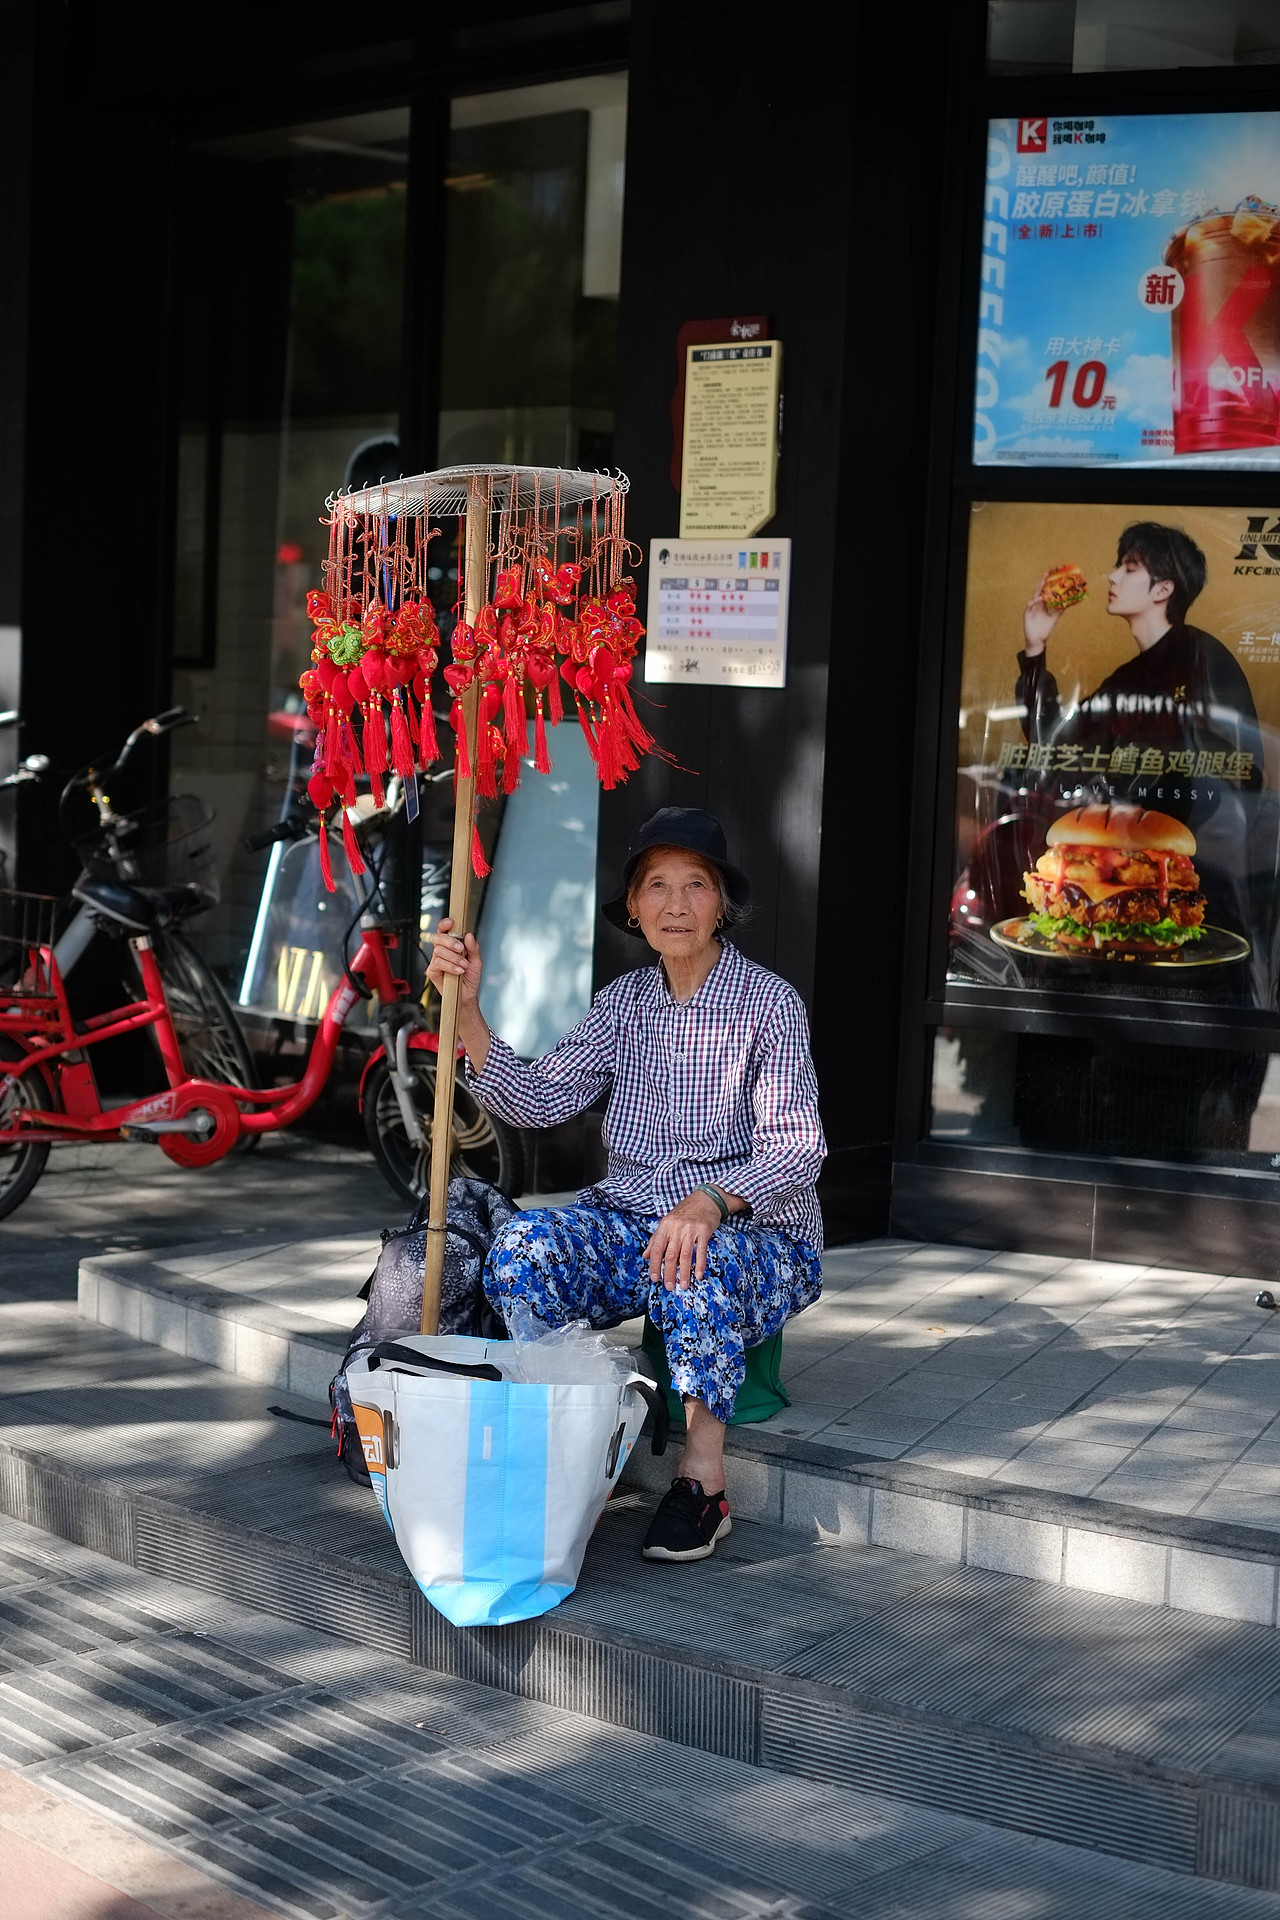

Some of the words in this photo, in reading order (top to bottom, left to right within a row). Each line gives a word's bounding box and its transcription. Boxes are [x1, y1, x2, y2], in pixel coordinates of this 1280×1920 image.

[1011, 189, 1209, 219] 胶原蛋白冰拿铁
[1145, 274, 1176, 305] 新
[1044, 336, 1121, 357] 用大神卡
[996, 741, 1255, 780] 脏脏芝士鳕鱼鸡腿堡
[1059, 783, 1116, 797] LOVE
[1138, 786, 1215, 801] MESSY
[142, 1095, 170, 1114] KFC
